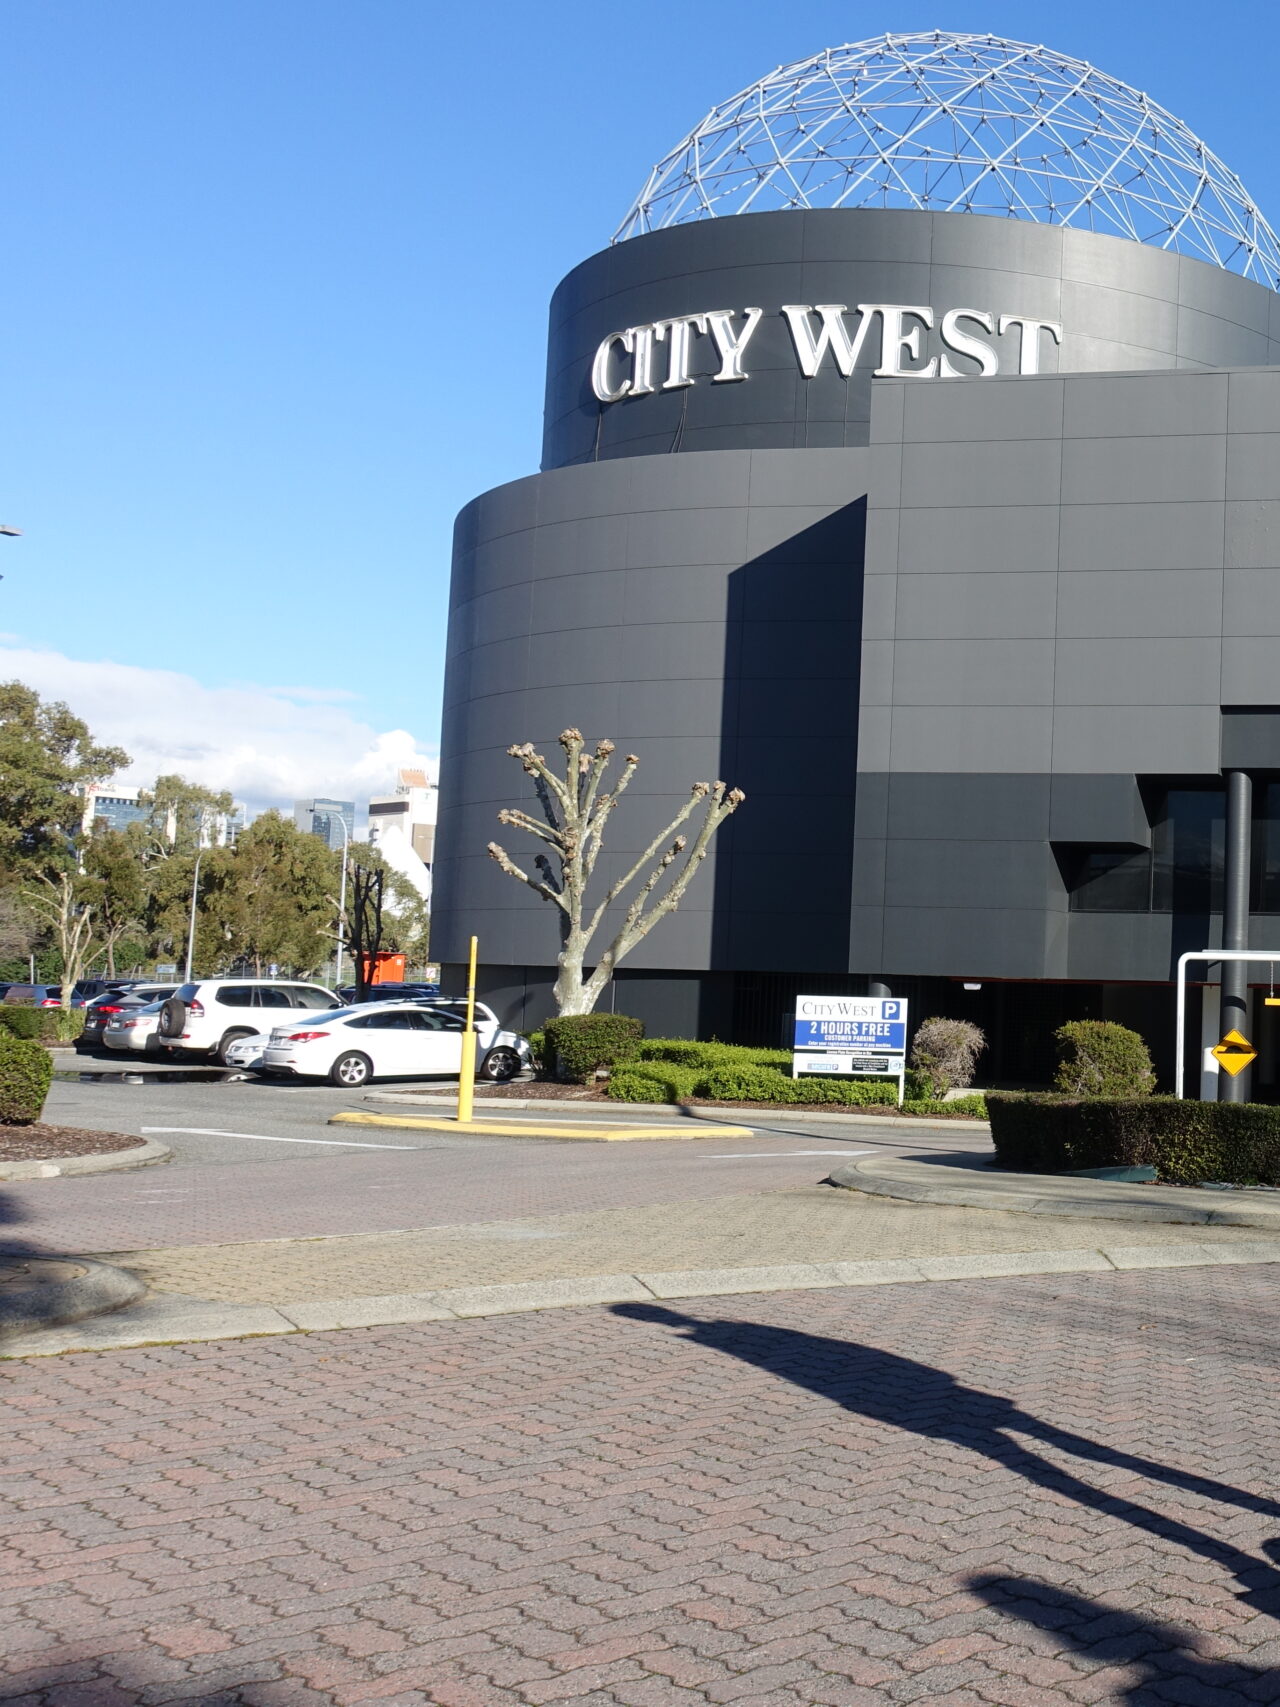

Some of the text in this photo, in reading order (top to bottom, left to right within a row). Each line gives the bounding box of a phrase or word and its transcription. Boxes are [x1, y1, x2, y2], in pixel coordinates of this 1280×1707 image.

[591, 303, 1064, 403] CITY WEST
[810, 1021, 890, 1036] 2 HOURS FREE
[824, 1034, 852, 1042] CUSTOMER
